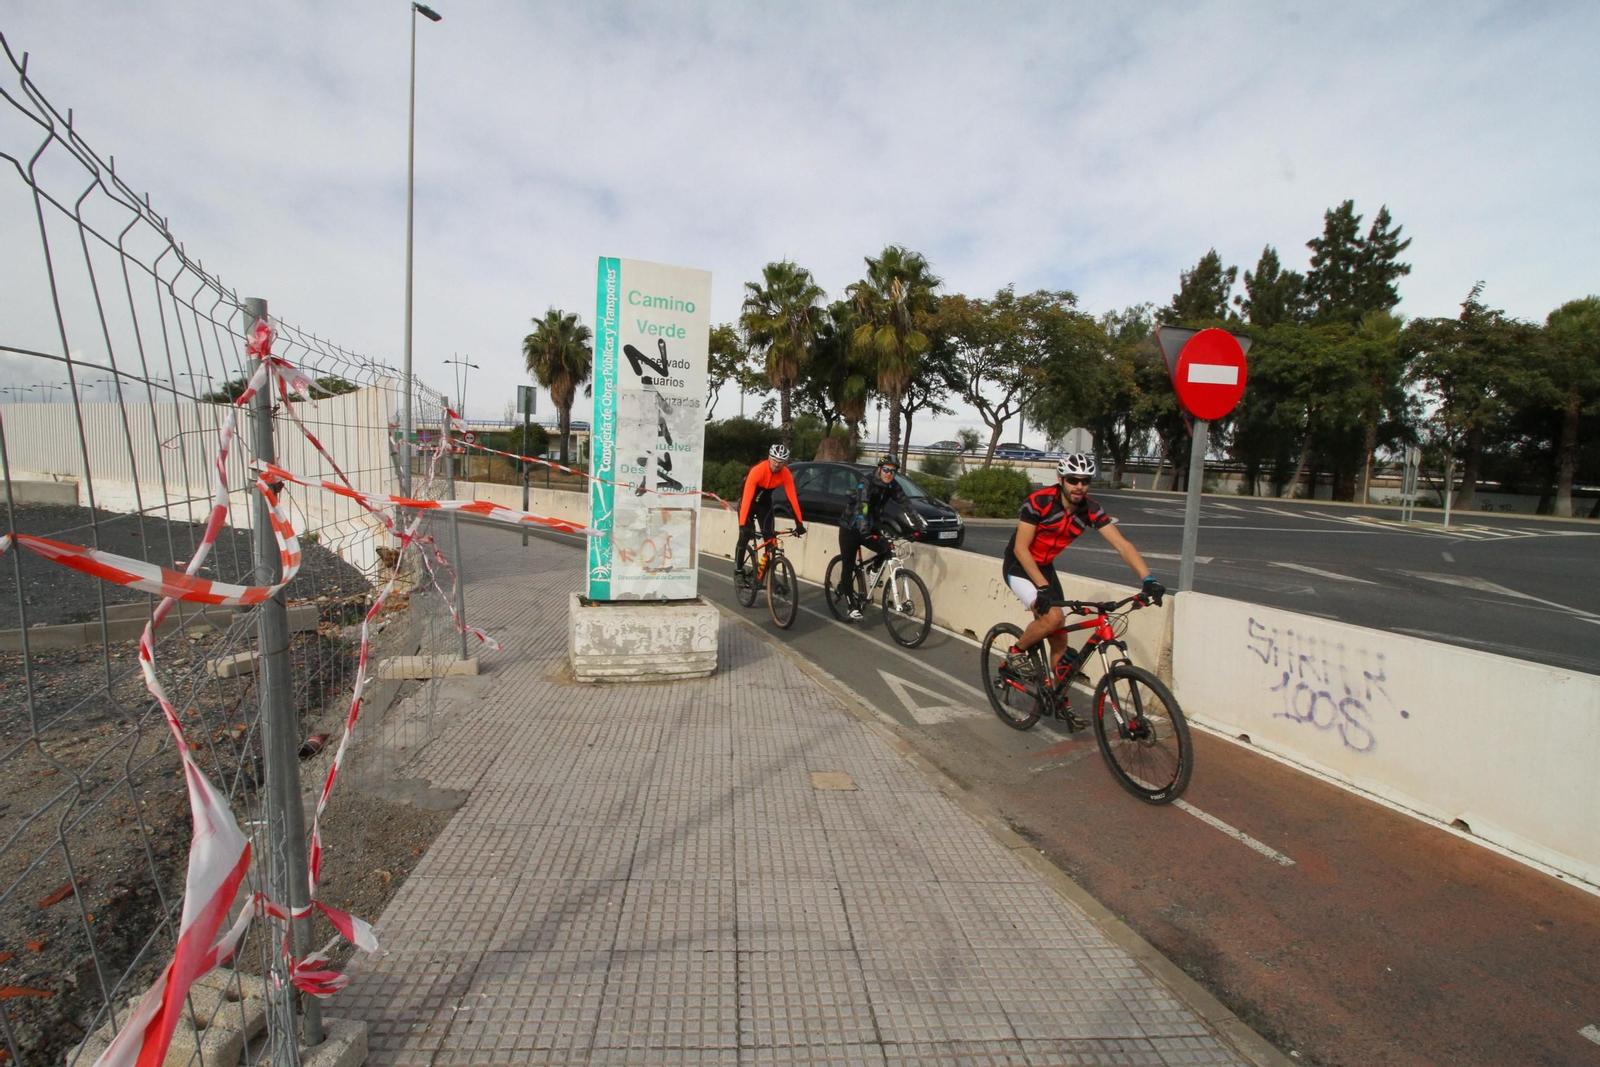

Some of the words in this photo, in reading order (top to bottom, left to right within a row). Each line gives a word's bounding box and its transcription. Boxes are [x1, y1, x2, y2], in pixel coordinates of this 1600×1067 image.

[605, 268, 618, 326] Transportes
[628, 290, 696, 314] Camino
[636, 318, 687, 340] Verde
[603, 336, 616, 375] Públicas
[602, 377, 614, 407] Obras
[601, 408, 612, 421] de
[600, 422, 614, 472] Consejería
